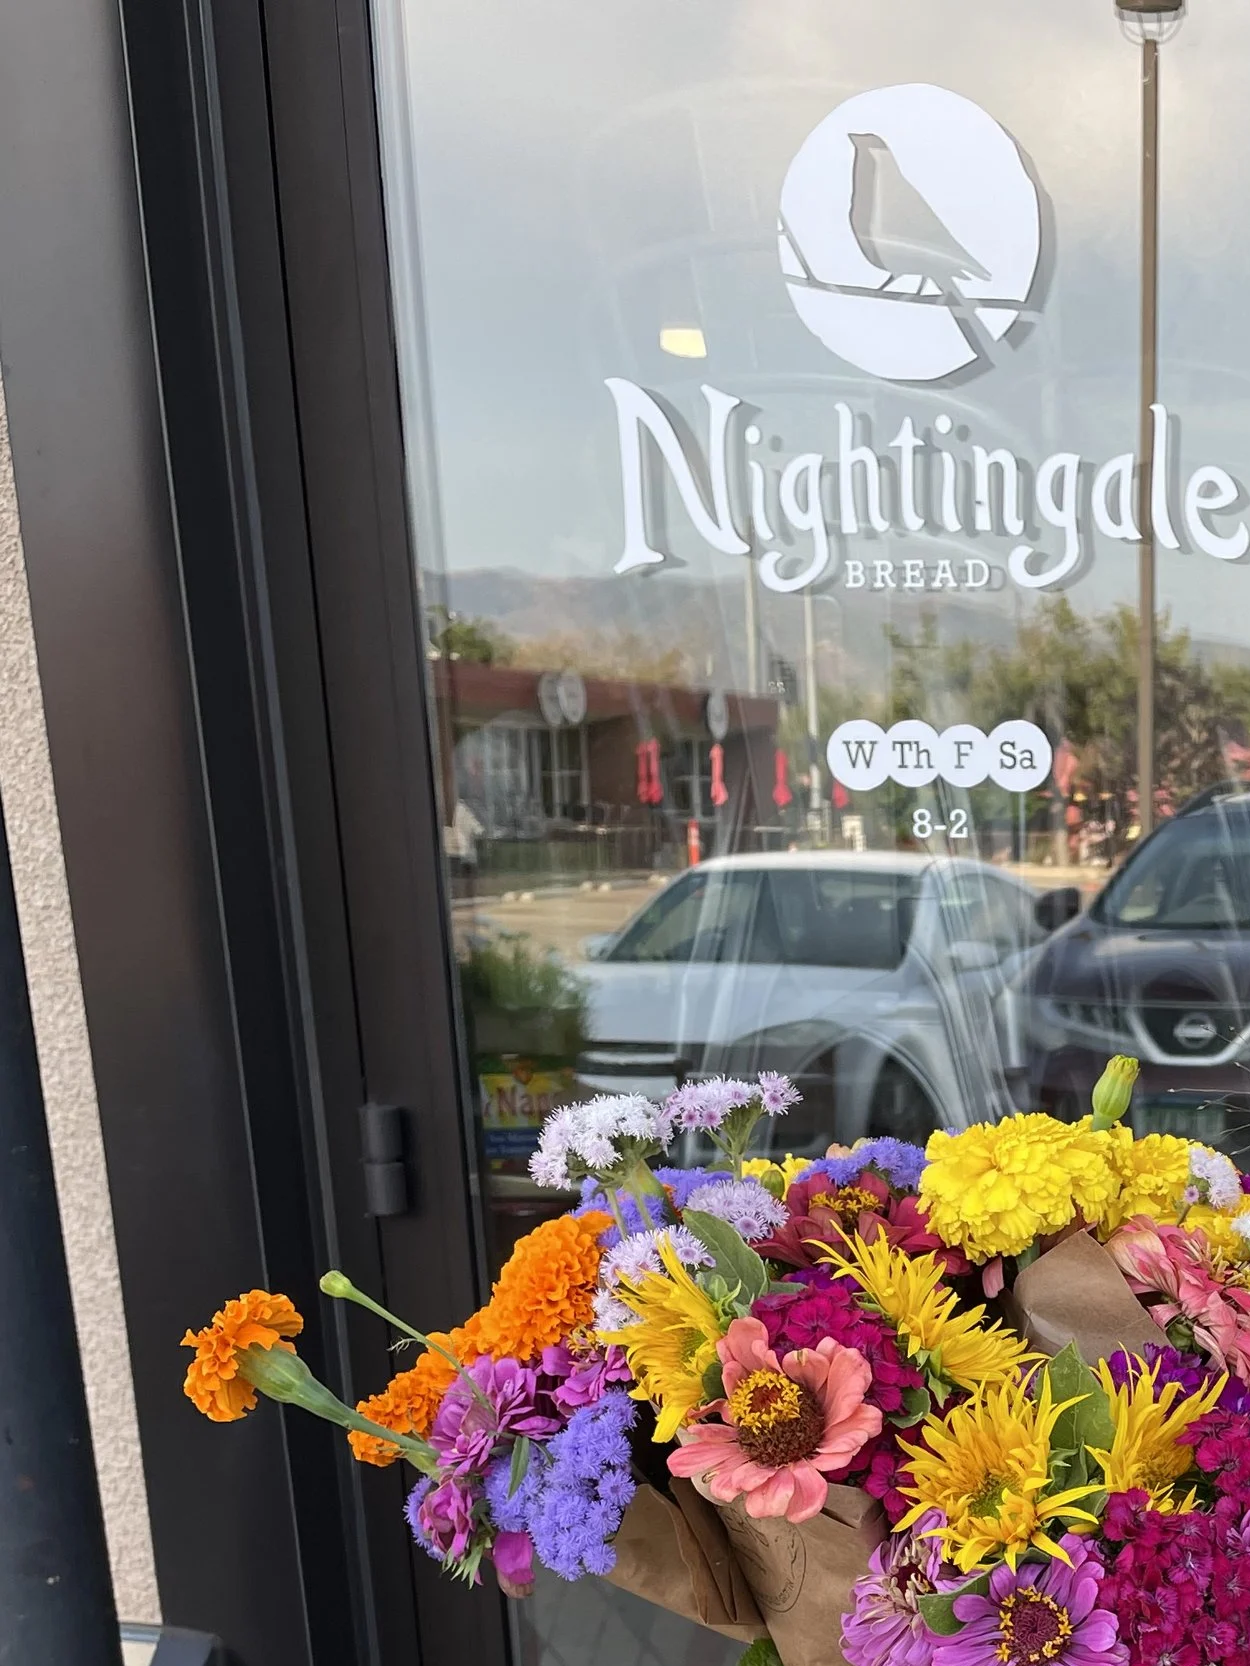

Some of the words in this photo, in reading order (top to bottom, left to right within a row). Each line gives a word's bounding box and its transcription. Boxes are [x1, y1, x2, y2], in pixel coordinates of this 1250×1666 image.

[604, 377, 1250, 592] Nightingale
[845, 561, 989, 587] BREAD
[843, 741, 878, 770] W
[892, 741, 934, 769] Th
[954, 742, 973, 769] F
[999, 742, 1036, 771] Sa
[912, 809, 968, 838] 8-2
